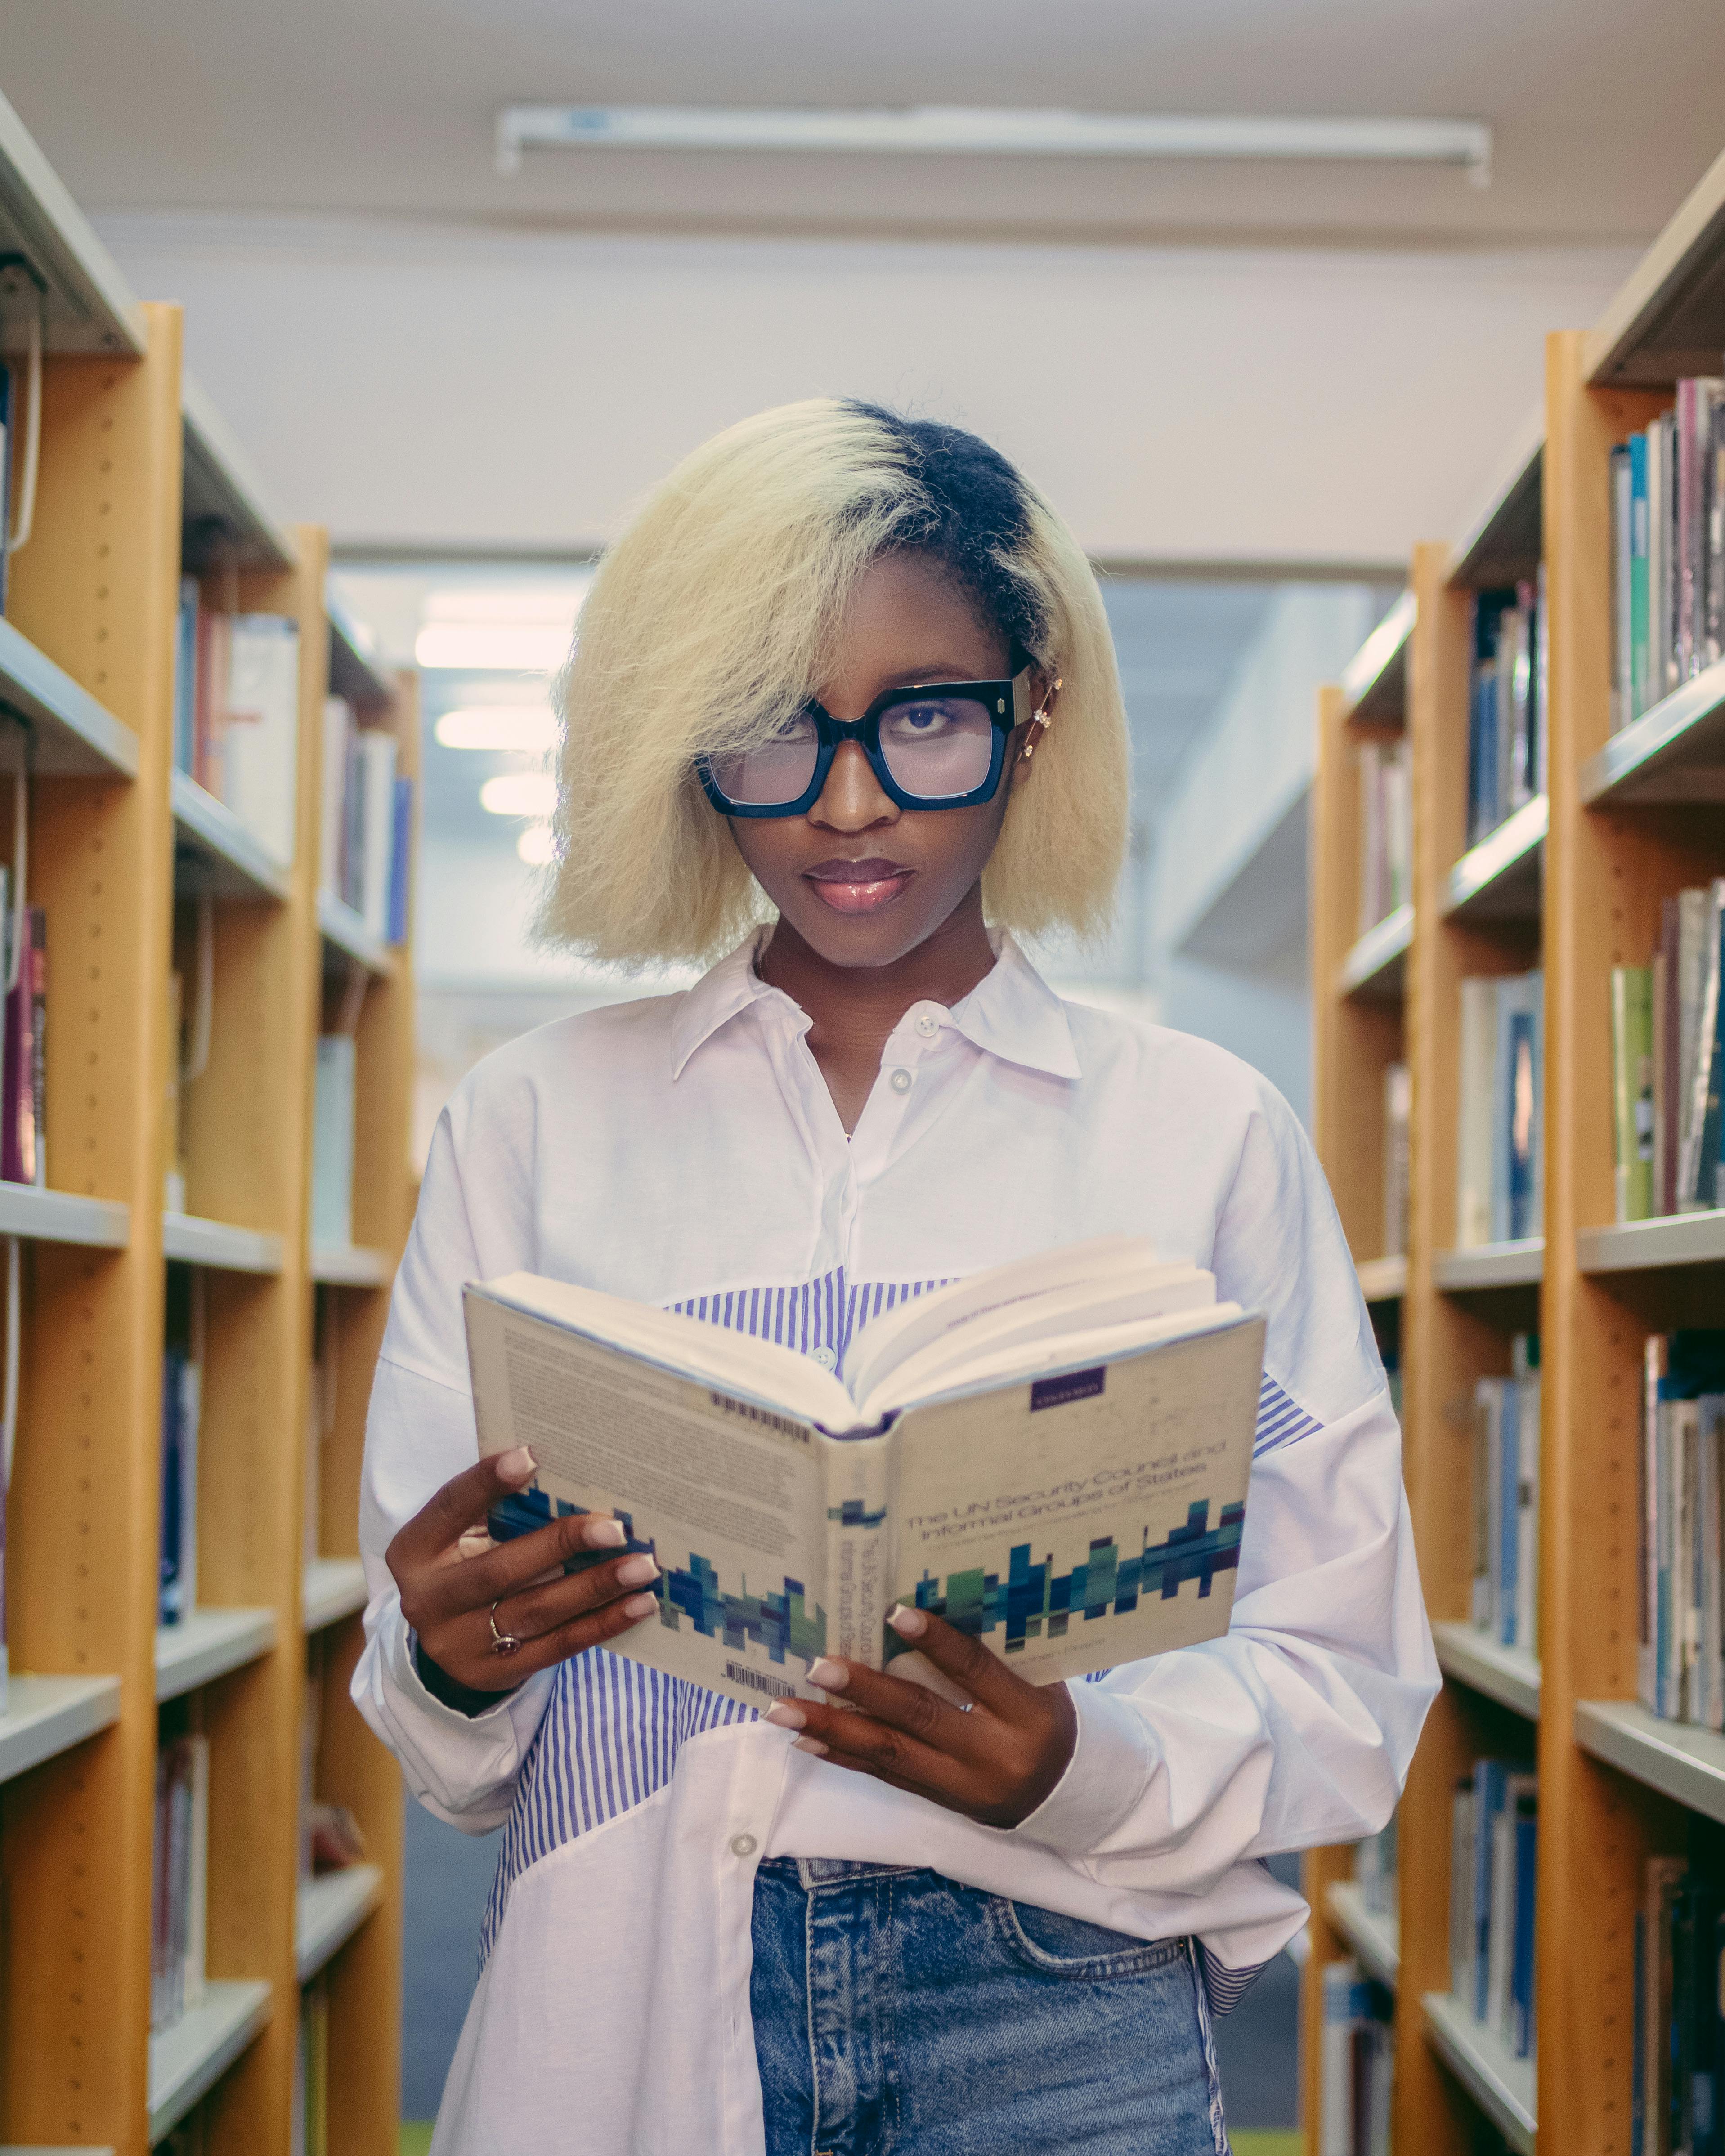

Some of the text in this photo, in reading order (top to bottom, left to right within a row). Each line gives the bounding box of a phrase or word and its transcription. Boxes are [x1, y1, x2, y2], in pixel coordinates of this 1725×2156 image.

[907, 1440, 1227, 1530] The UN Security Council and
[922, 1510, 1012, 1540] Informal
[1017, 1490, 1103, 1519] Groups
[1108, 1481, 1131, 1496] of
[1137, 1463, 1206, 1490] States
[858, 1576, 878, 1617] Security
